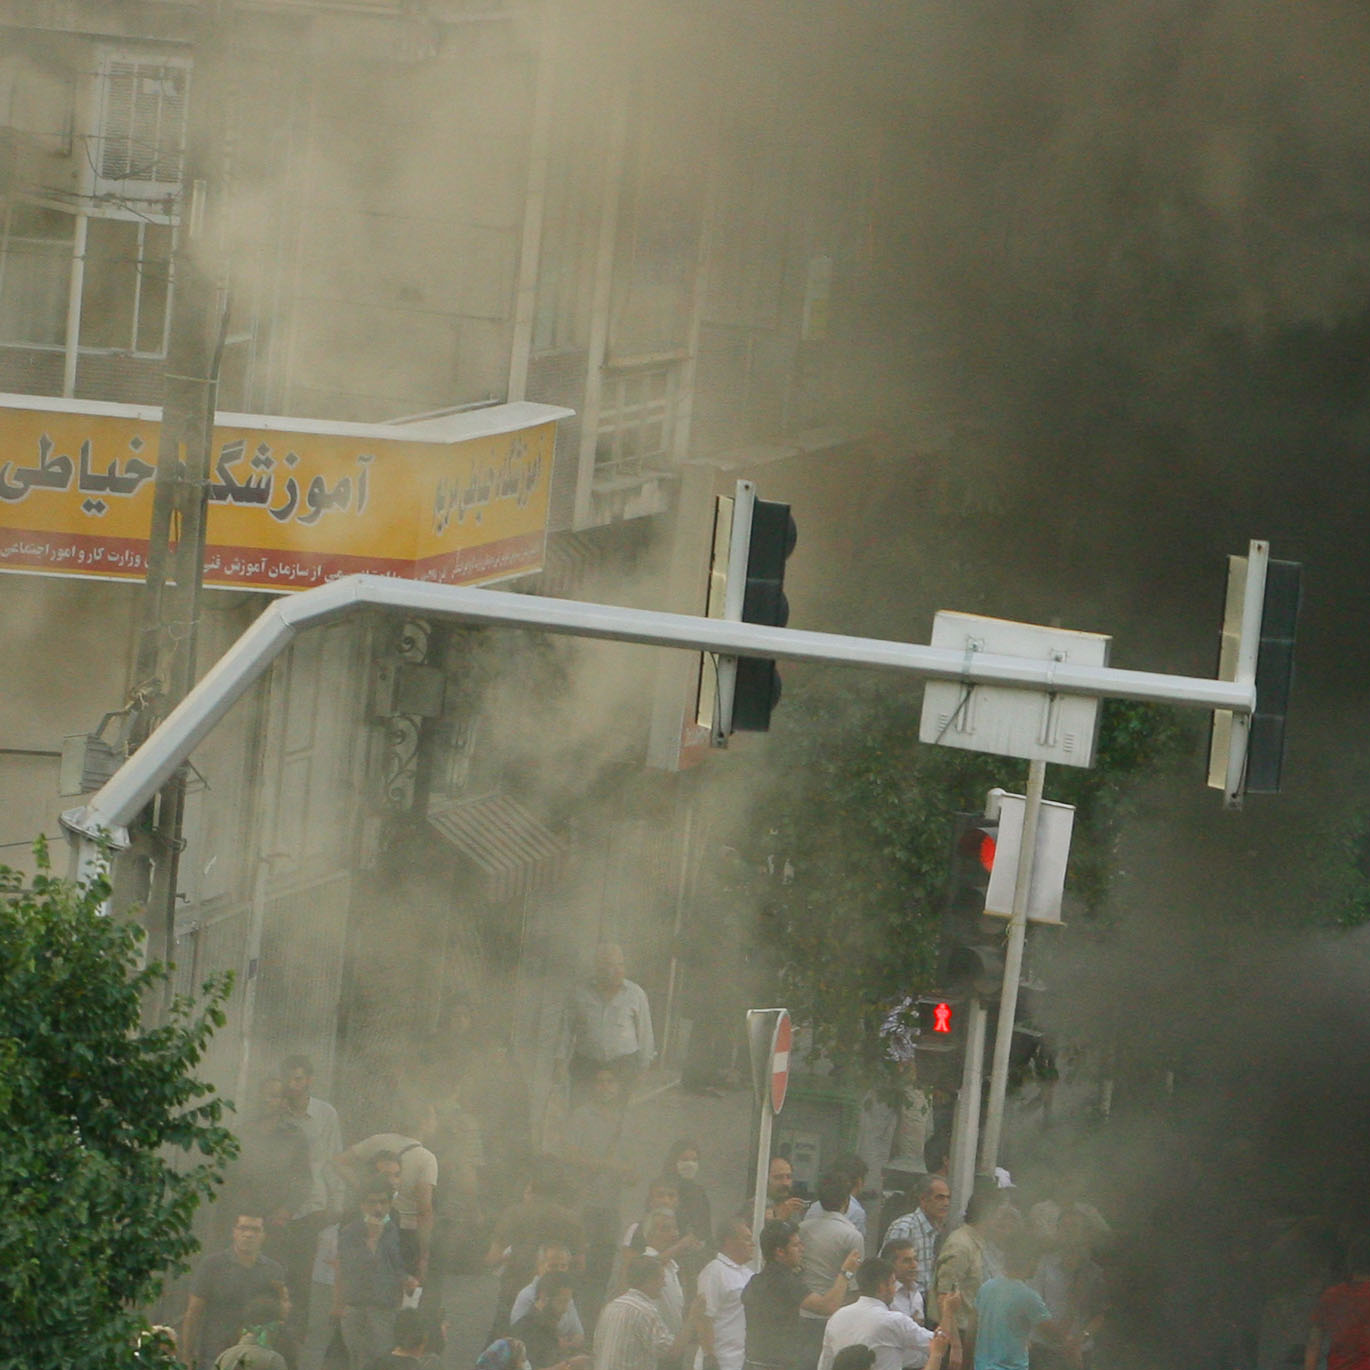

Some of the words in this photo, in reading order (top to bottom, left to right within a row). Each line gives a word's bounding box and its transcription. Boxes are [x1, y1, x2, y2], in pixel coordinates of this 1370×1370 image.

[0, 433, 157, 518] خیاطی
[1, 543, 49, 558] اجتماعی
[50, 545, 76, 562] امور
[78, 550, 85, 563] و
[86, 548, 105, 563] کار
[107, 549, 142, 568] وزارت
[224, 557, 268, 577] آموزش
[268, 562, 308, 581] سازمان
[310, 564, 322, 581] از
